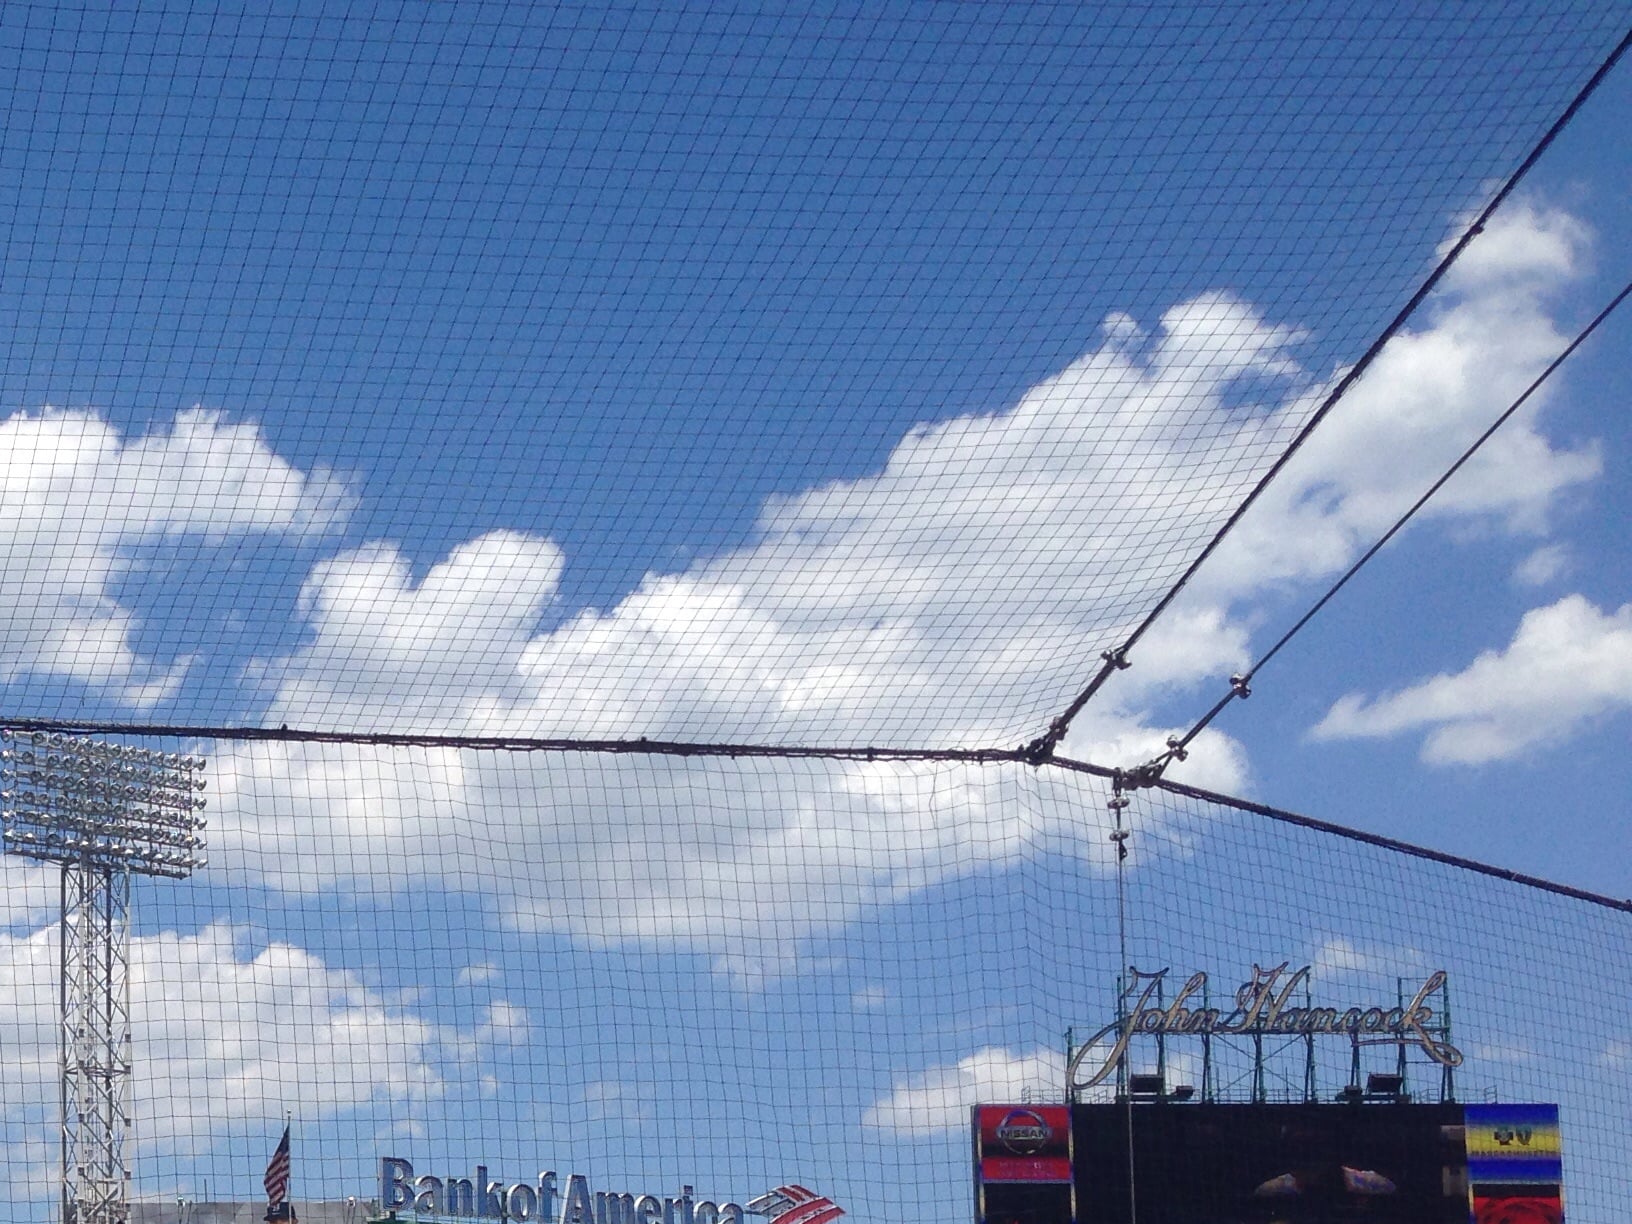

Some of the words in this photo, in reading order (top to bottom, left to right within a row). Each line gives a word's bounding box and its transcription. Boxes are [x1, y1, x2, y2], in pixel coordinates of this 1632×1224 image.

[1069, 965, 1219, 1090] John
[1214, 962, 1465, 1067] Hancock
[1000, 1129, 1049, 1140] NISSAN
